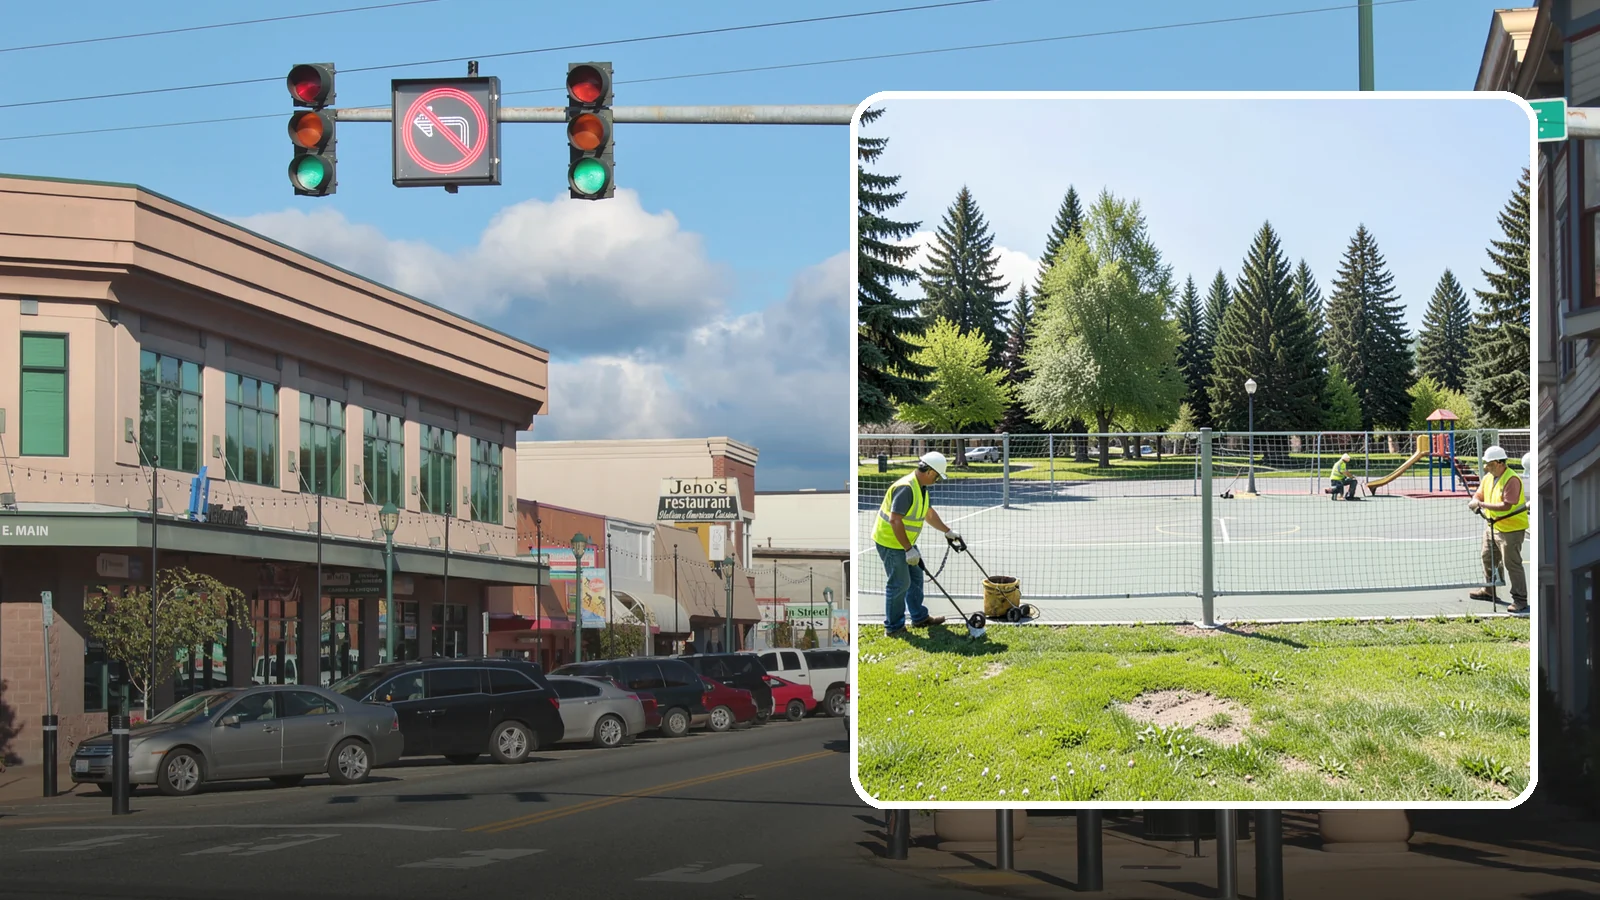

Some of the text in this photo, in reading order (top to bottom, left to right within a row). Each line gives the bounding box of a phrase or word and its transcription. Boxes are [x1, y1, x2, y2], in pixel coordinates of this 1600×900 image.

[669, 480, 728, 495] Jeno's
[664, 496, 731, 509] restaurant
[685, 509, 715, 519] American
[715, 509, 738, 519] Cuisine
[2, 525, 49, 537] E. MAIN
[797, 607, 829, 617] Street
